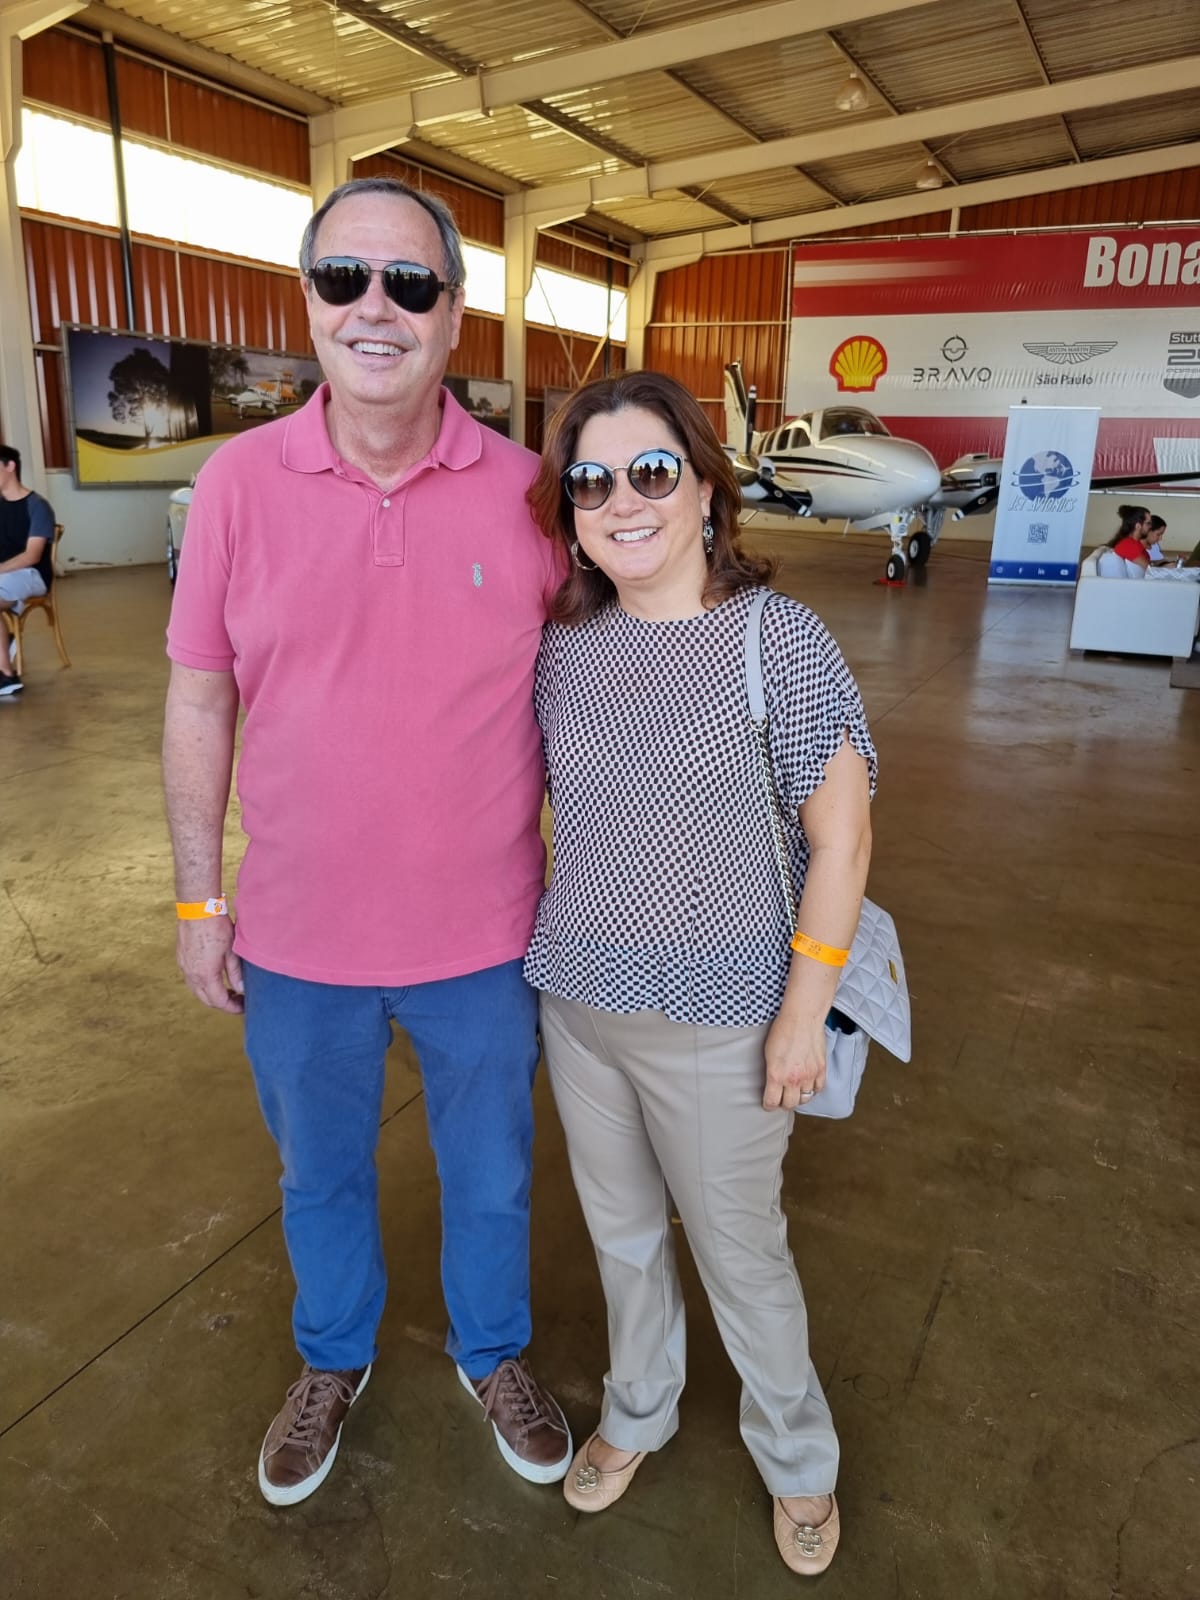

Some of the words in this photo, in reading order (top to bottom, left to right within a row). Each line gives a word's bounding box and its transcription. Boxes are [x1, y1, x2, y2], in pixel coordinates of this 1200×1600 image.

[1083, 236, 1200, 288] Bona
[913, 367, 991, 382] BRAVO
[1036, 374, 1058, 385] São
[1060, 374, 1094, 385] Paulo
